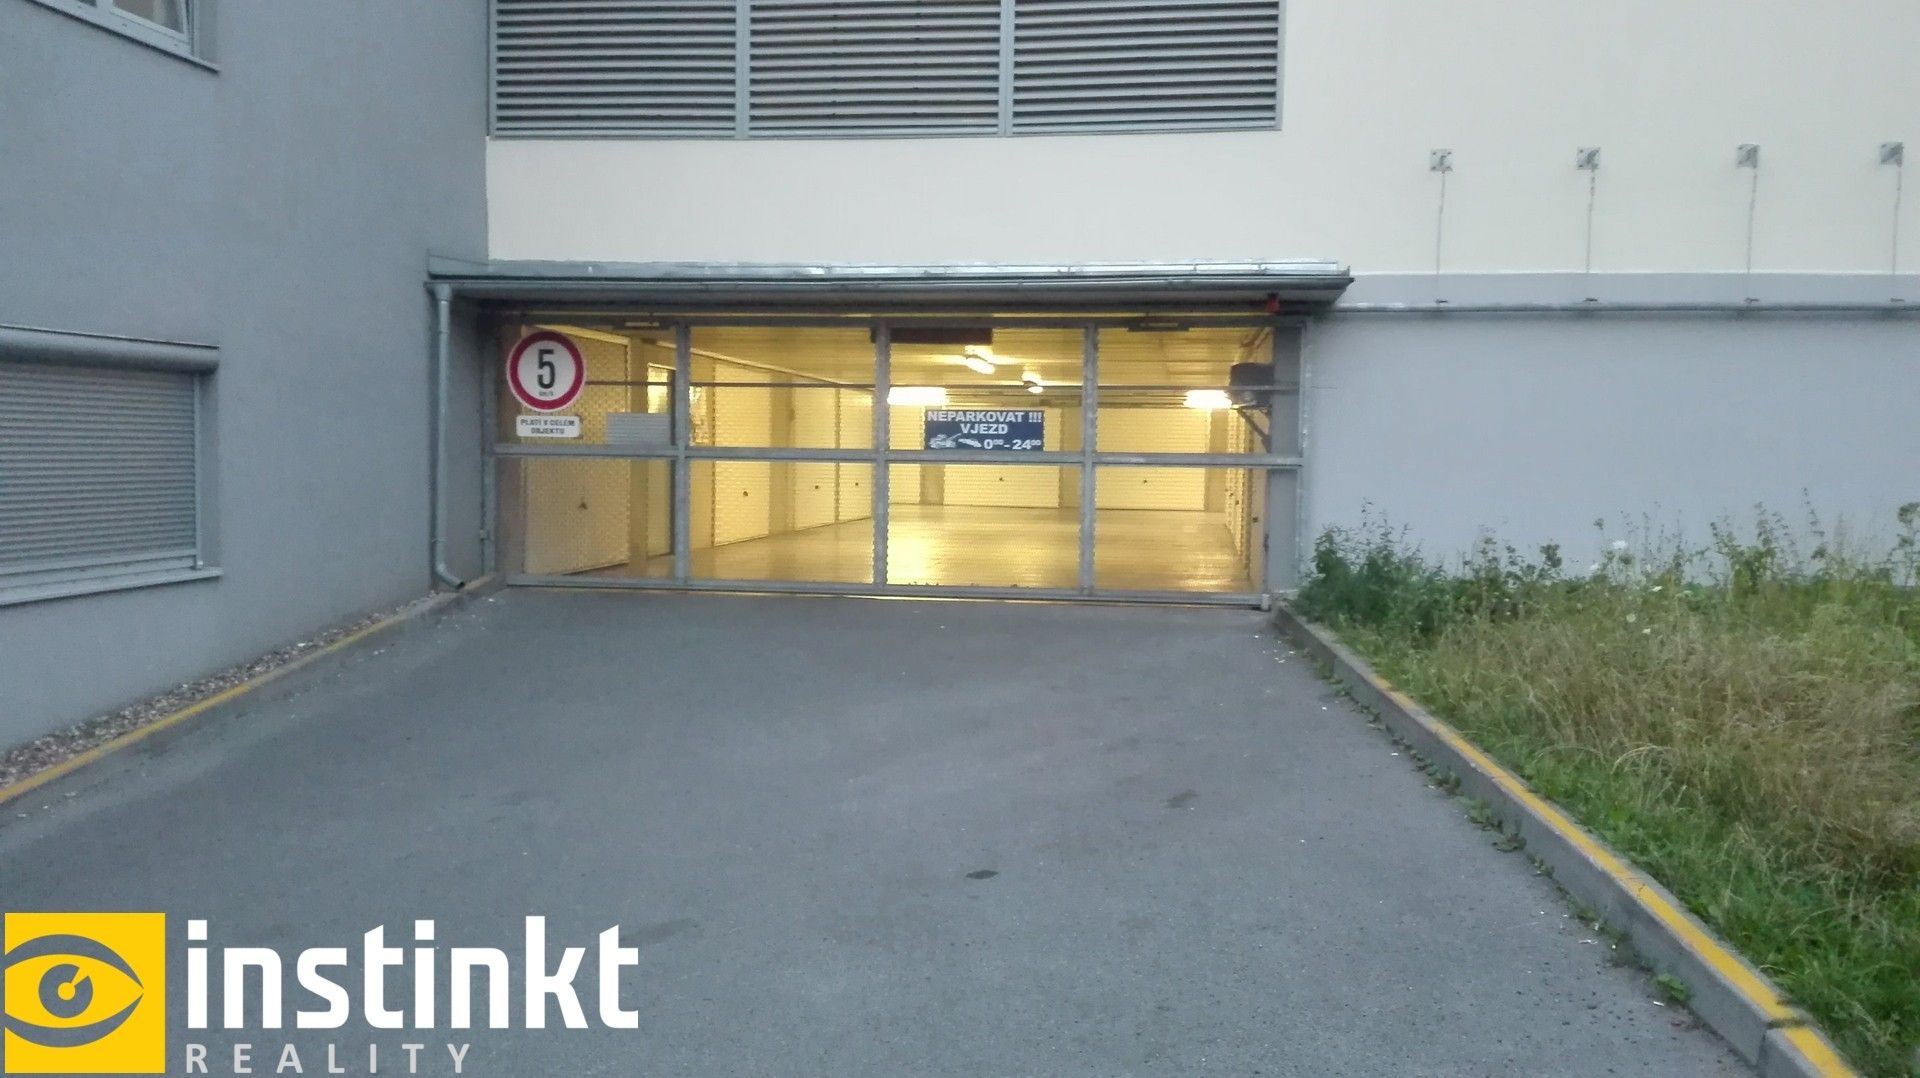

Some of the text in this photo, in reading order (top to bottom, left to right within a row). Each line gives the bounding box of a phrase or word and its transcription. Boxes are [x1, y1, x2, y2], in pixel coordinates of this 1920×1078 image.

[537, 349, 556, 389] 5
[927, 411, 1024, 422] NEPARKOVAT
[960, 423, 1008, 434] VJEZD
